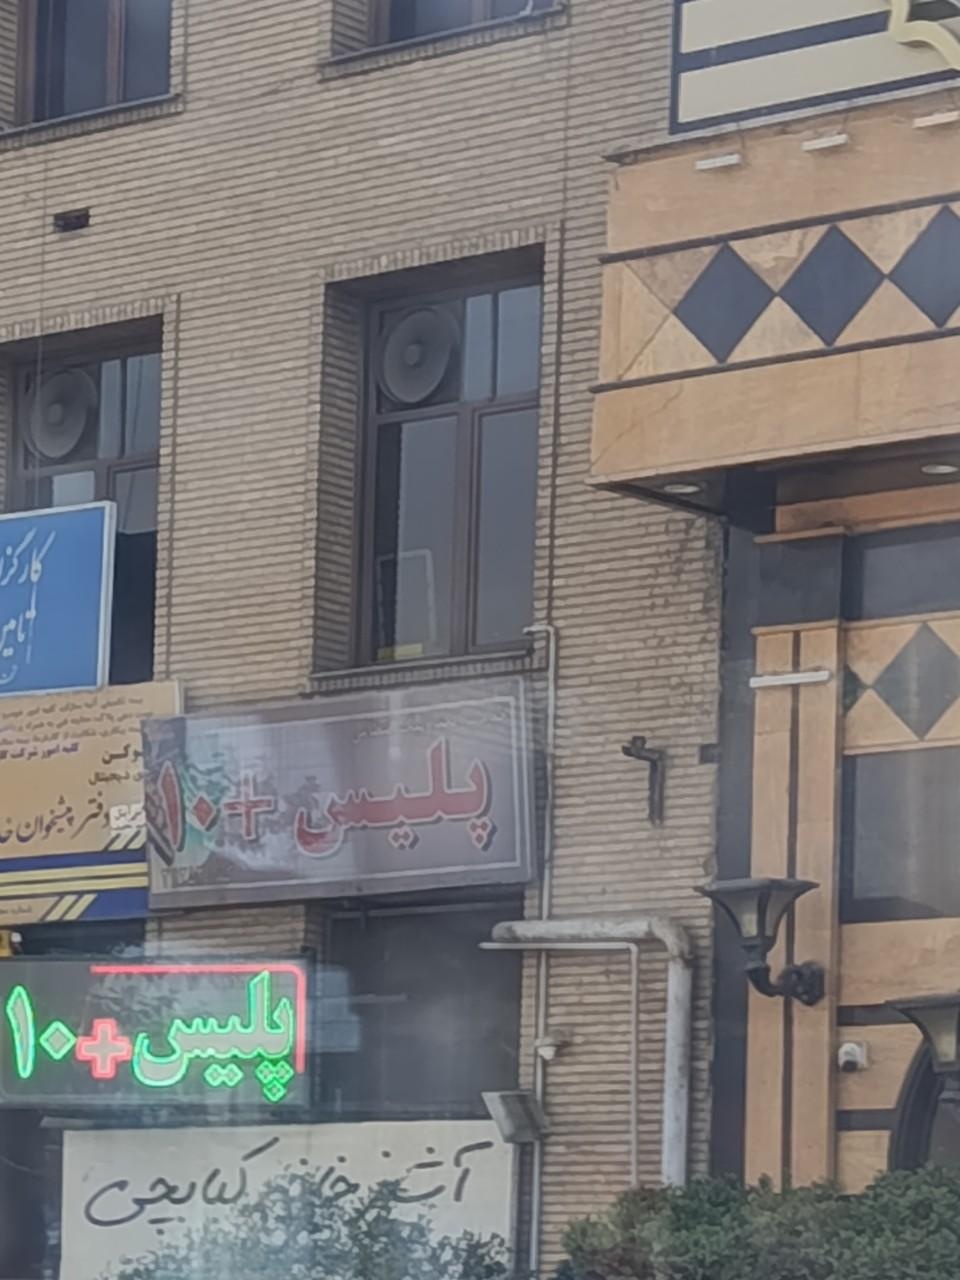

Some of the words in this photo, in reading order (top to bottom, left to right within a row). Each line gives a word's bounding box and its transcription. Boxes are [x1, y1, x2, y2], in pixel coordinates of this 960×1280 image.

[16, 794, 75, 842] پیشخوان
[71, 790, 111, 840] دفتر
[293, 736, 493, 858] پلیس
